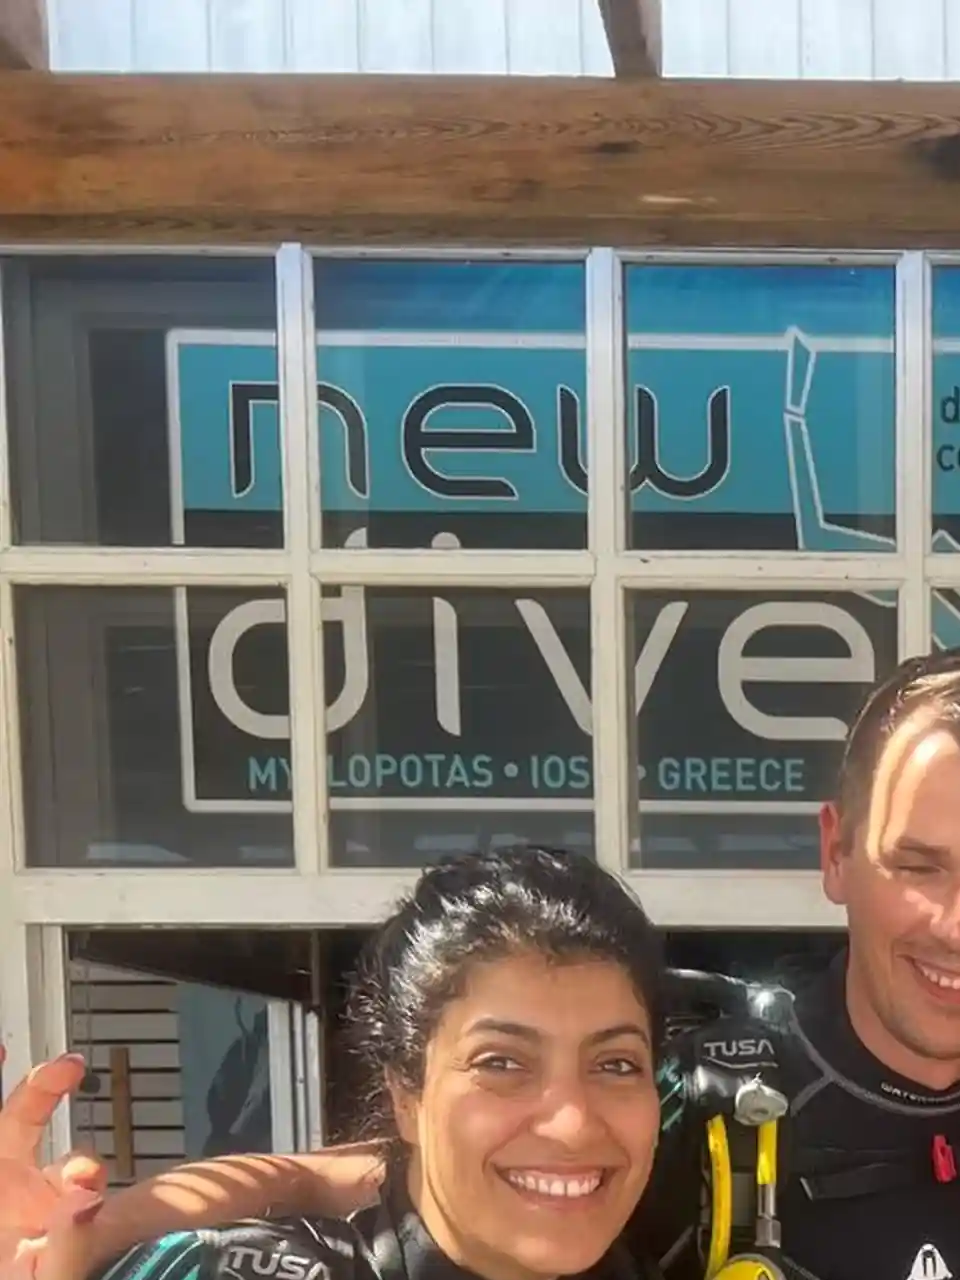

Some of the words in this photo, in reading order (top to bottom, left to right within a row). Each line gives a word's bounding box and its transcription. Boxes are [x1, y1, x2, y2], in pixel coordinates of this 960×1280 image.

[530, 755, 590, 789] IOS
[657, 757, 805, 792] GREECE
[703, 1039, 774, 1057] TUSA
